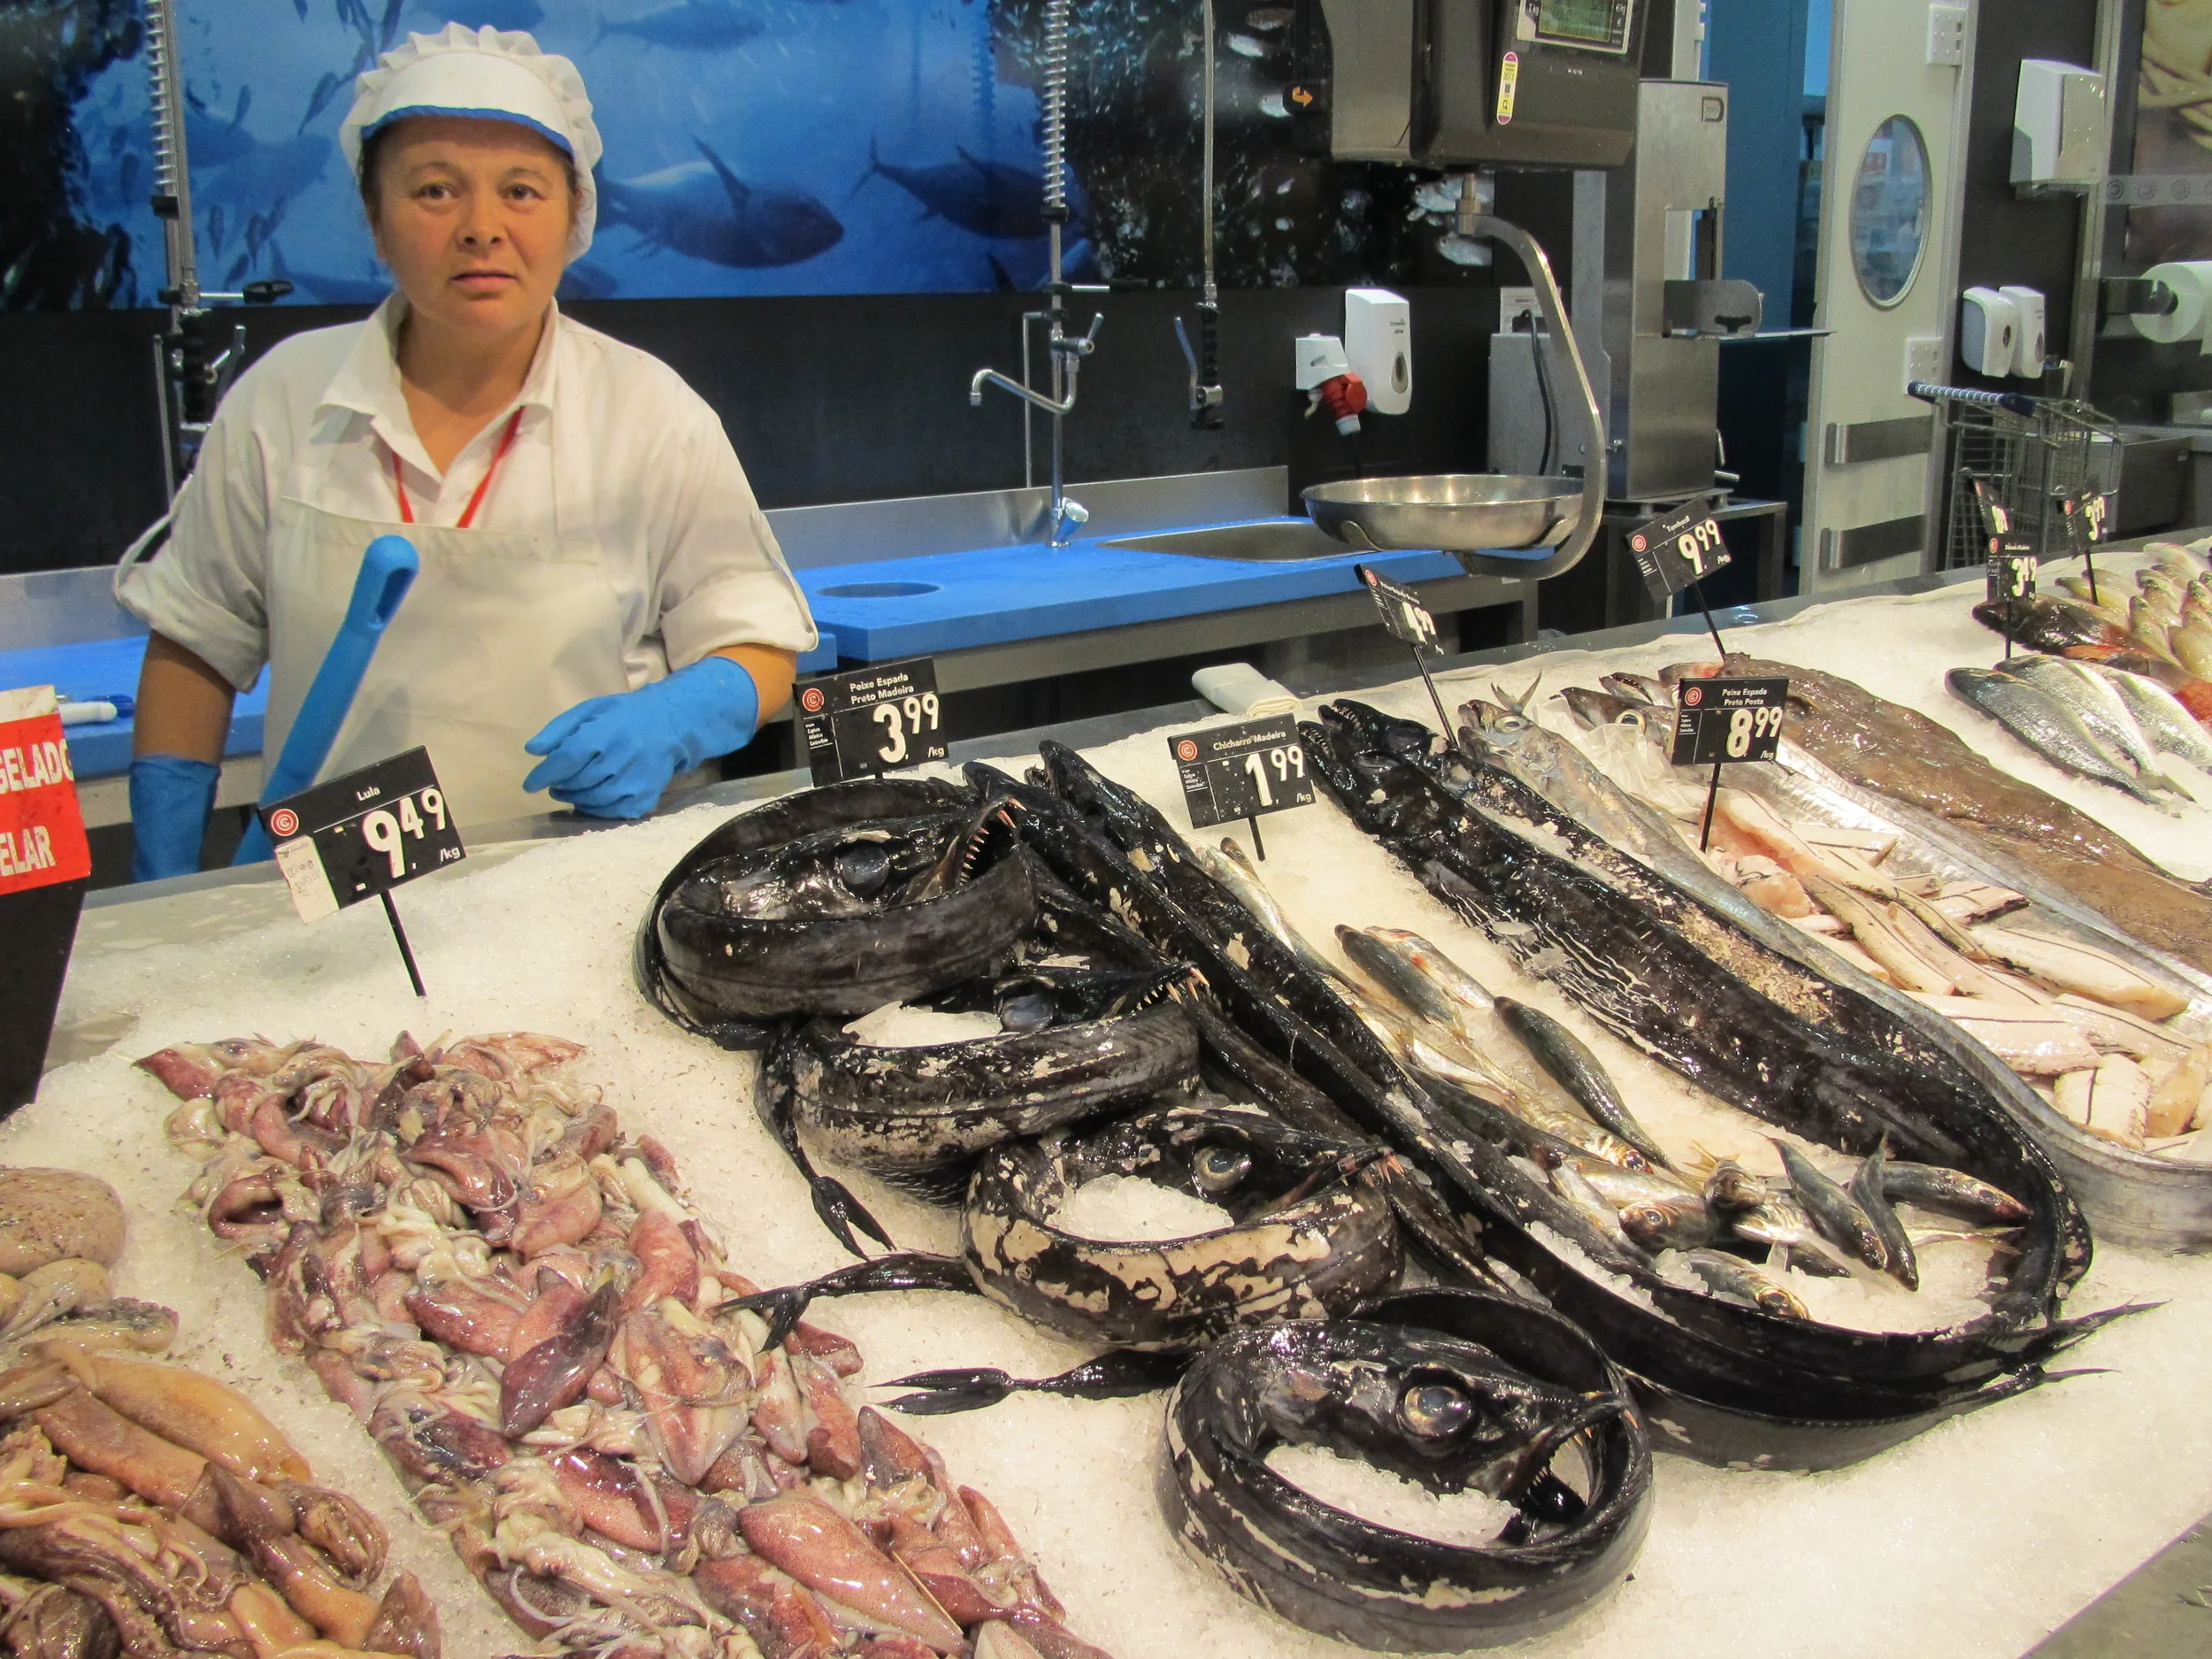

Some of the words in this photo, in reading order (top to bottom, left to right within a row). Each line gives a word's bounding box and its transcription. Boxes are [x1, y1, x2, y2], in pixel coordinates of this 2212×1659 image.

[849, 680, 874, 692] Peixe
[877, 672, 909, 687] Espada
[851, 694, 876, 704] Preto
[878, 685, 915, 699] Madeira
[1742, 687, 1768, 696] Espada
[1213, 737, 1251, 751] Chicharro
[1253, 731, 1286, 743] Madeira
[357, 786, 380, 802] Lula
[440, 846, 461, 863] /kg
